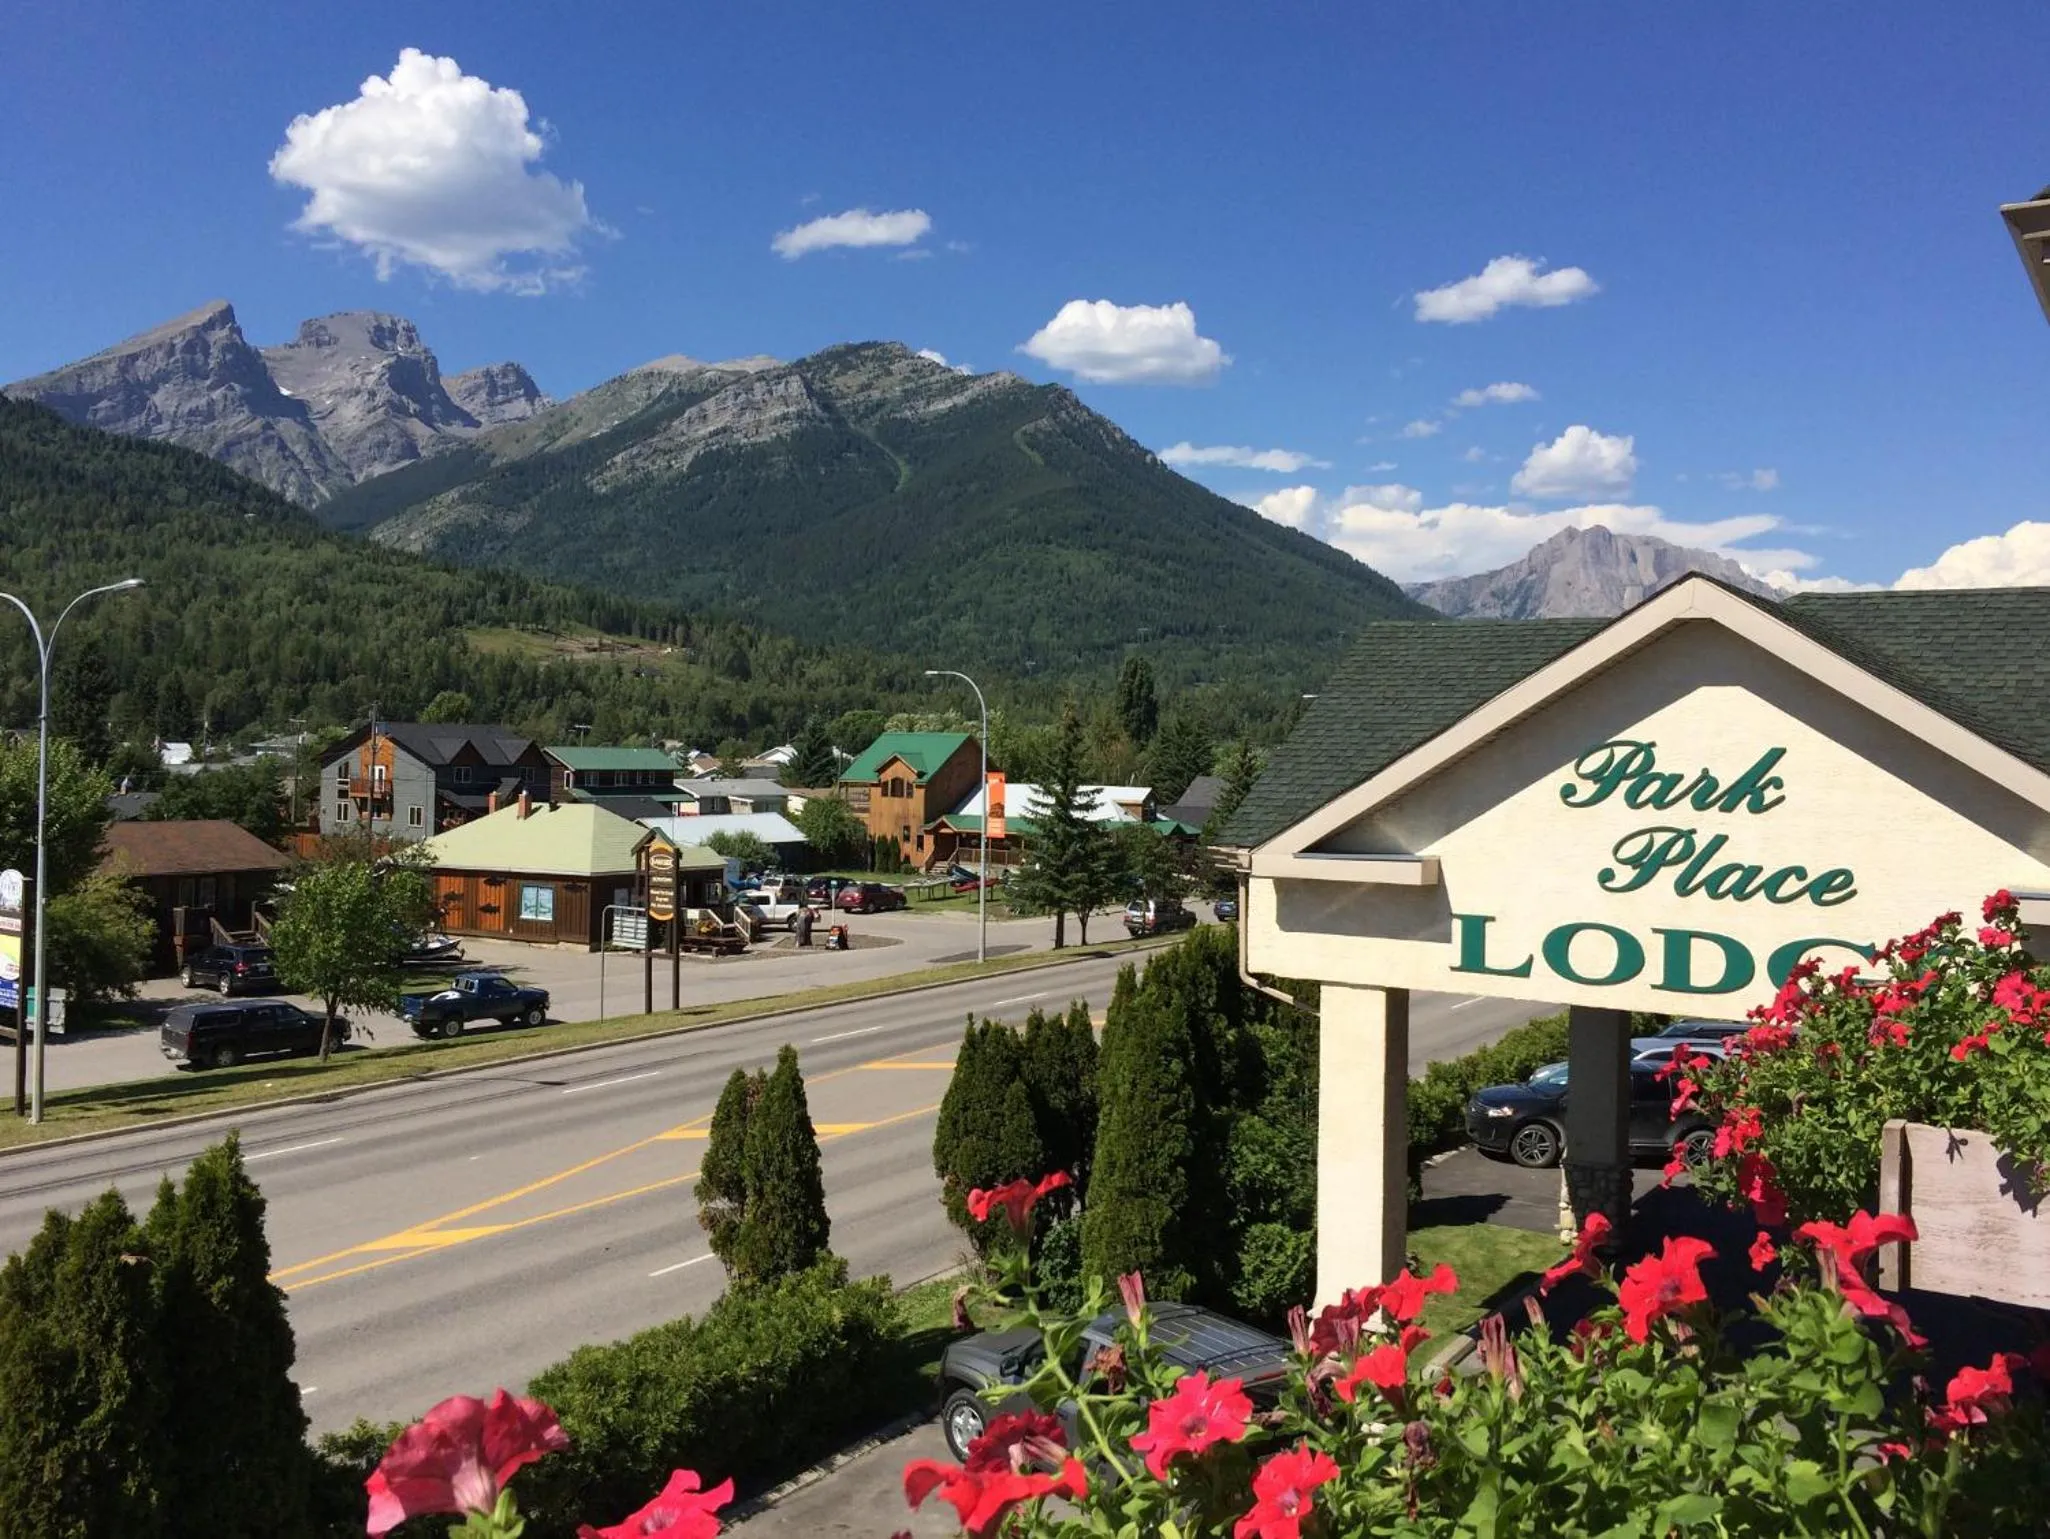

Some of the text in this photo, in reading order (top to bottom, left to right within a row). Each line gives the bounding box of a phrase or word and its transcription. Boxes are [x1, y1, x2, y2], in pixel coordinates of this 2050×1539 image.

[1560, 740, 1786, 814] Park
[1598, 826, 1858, 906] Place
[1448, 912, 1945, 996] LODG
